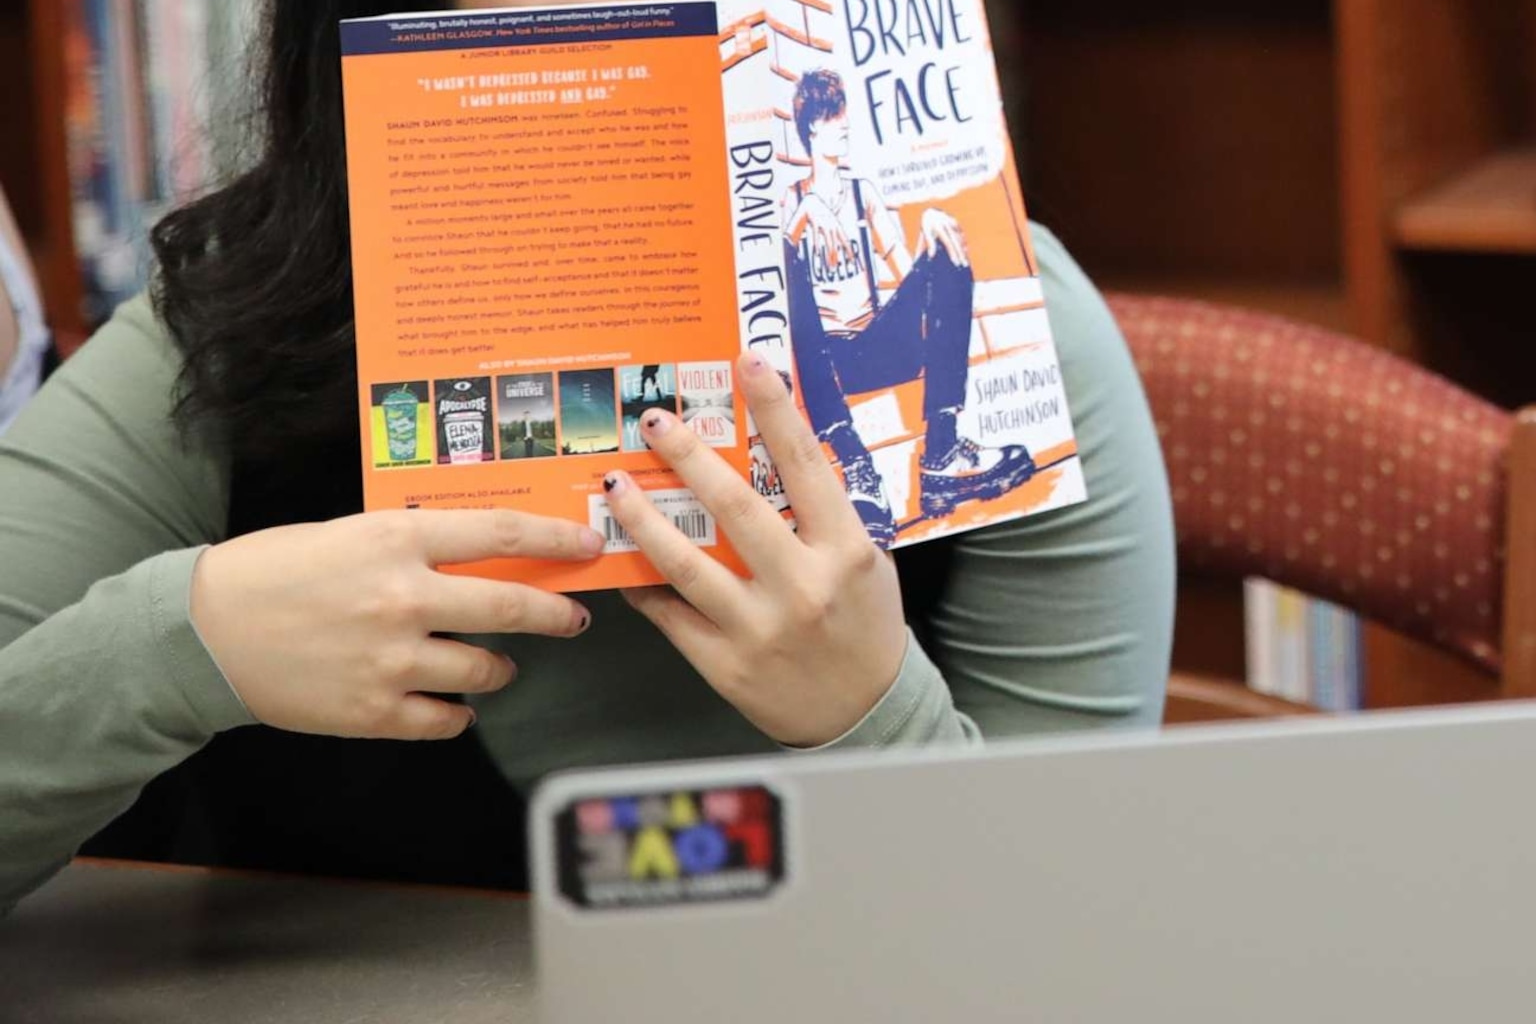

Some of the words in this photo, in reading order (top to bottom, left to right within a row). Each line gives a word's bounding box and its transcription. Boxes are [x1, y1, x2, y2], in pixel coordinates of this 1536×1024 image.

[600, 67, 622, 81] WAS
[470, 93, 492, 107] WAS
[865, 62, 973, 145] FACE
[730, 140, 779, 252] BRAVE
[739, 266, 787, 350] FACE
[680, 368, 729, 390] VIOLENT
[975, 372, 1018, 404] SHAUN
[506, 385, 544, 398] UNIVERSE
[439, 396, 487, 416] APOCALYPSE
[978, 397, 1059, 437] HUTCHINSON
[693, 417, 725, 437] ENDS
